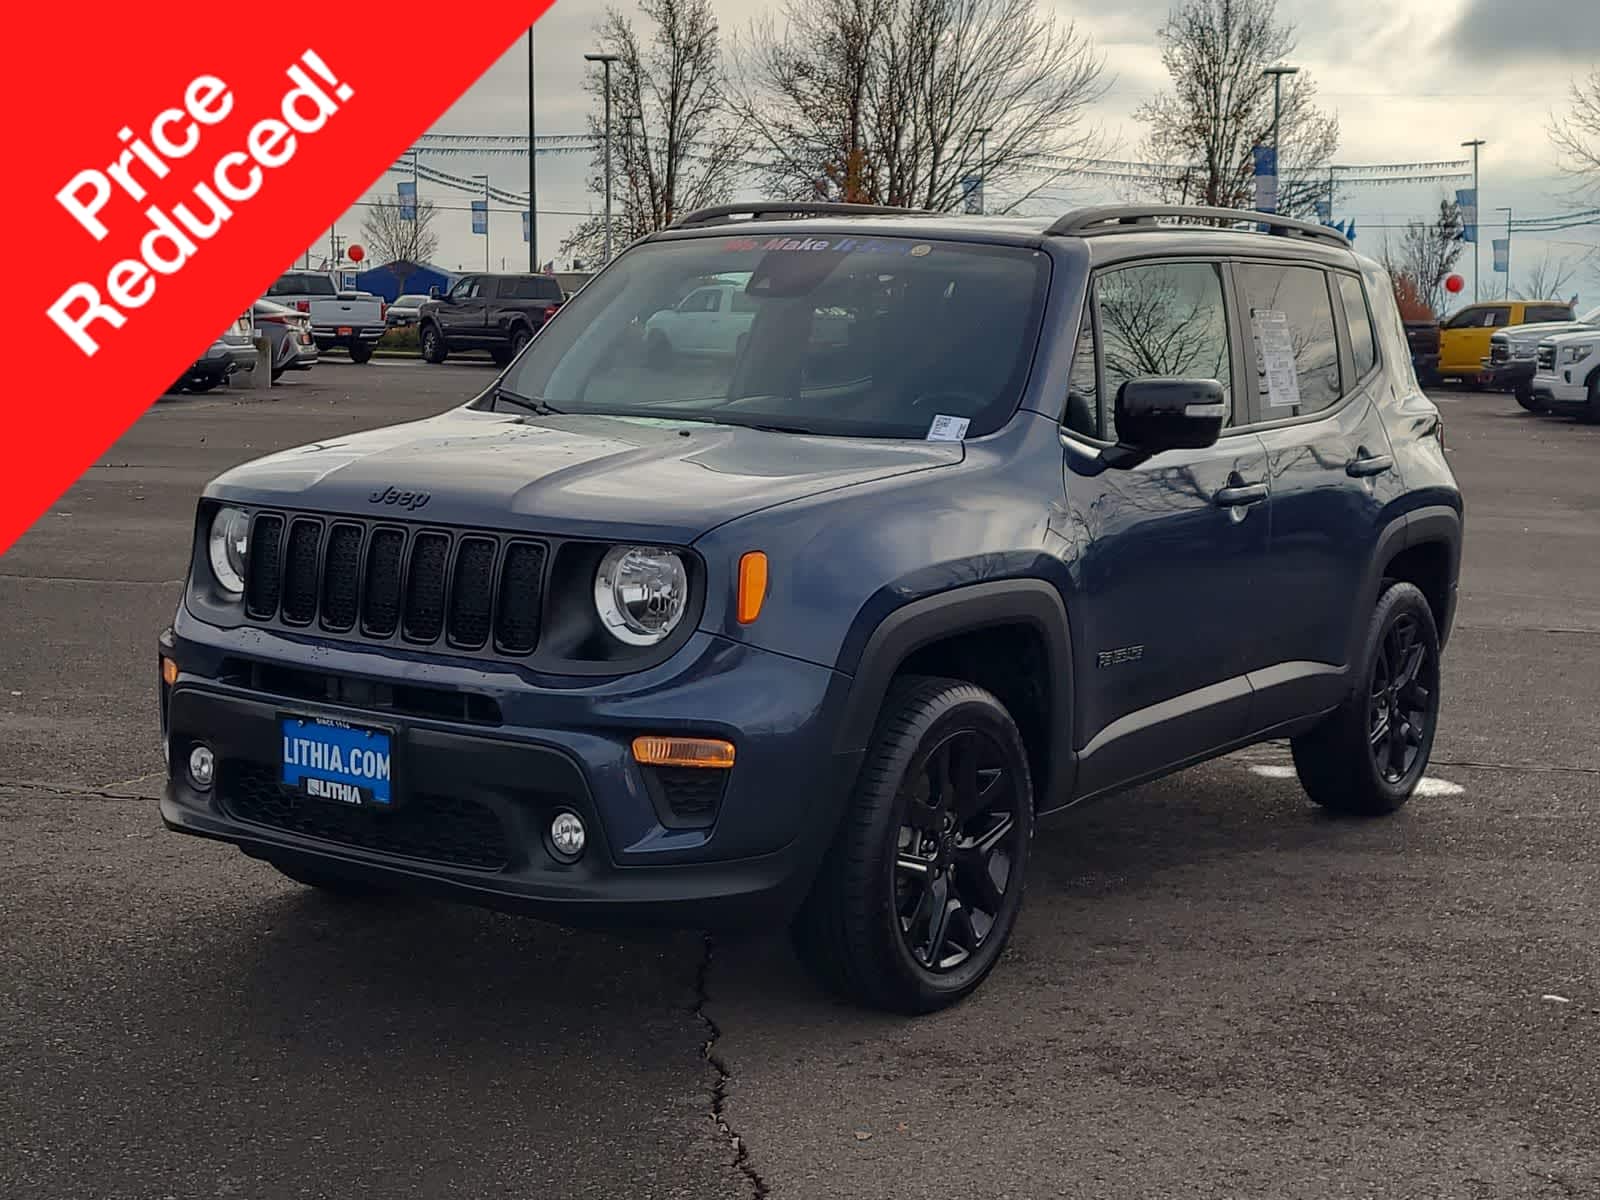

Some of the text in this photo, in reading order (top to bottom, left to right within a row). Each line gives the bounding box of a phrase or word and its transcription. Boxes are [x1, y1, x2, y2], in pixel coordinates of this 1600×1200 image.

[762, 238, 829, 251] Make
[368, 485, 431, 511] Jeep
[283, 736, 391, 781] LITHIA.COM
[319, 780, 362, 804] LITHIA
